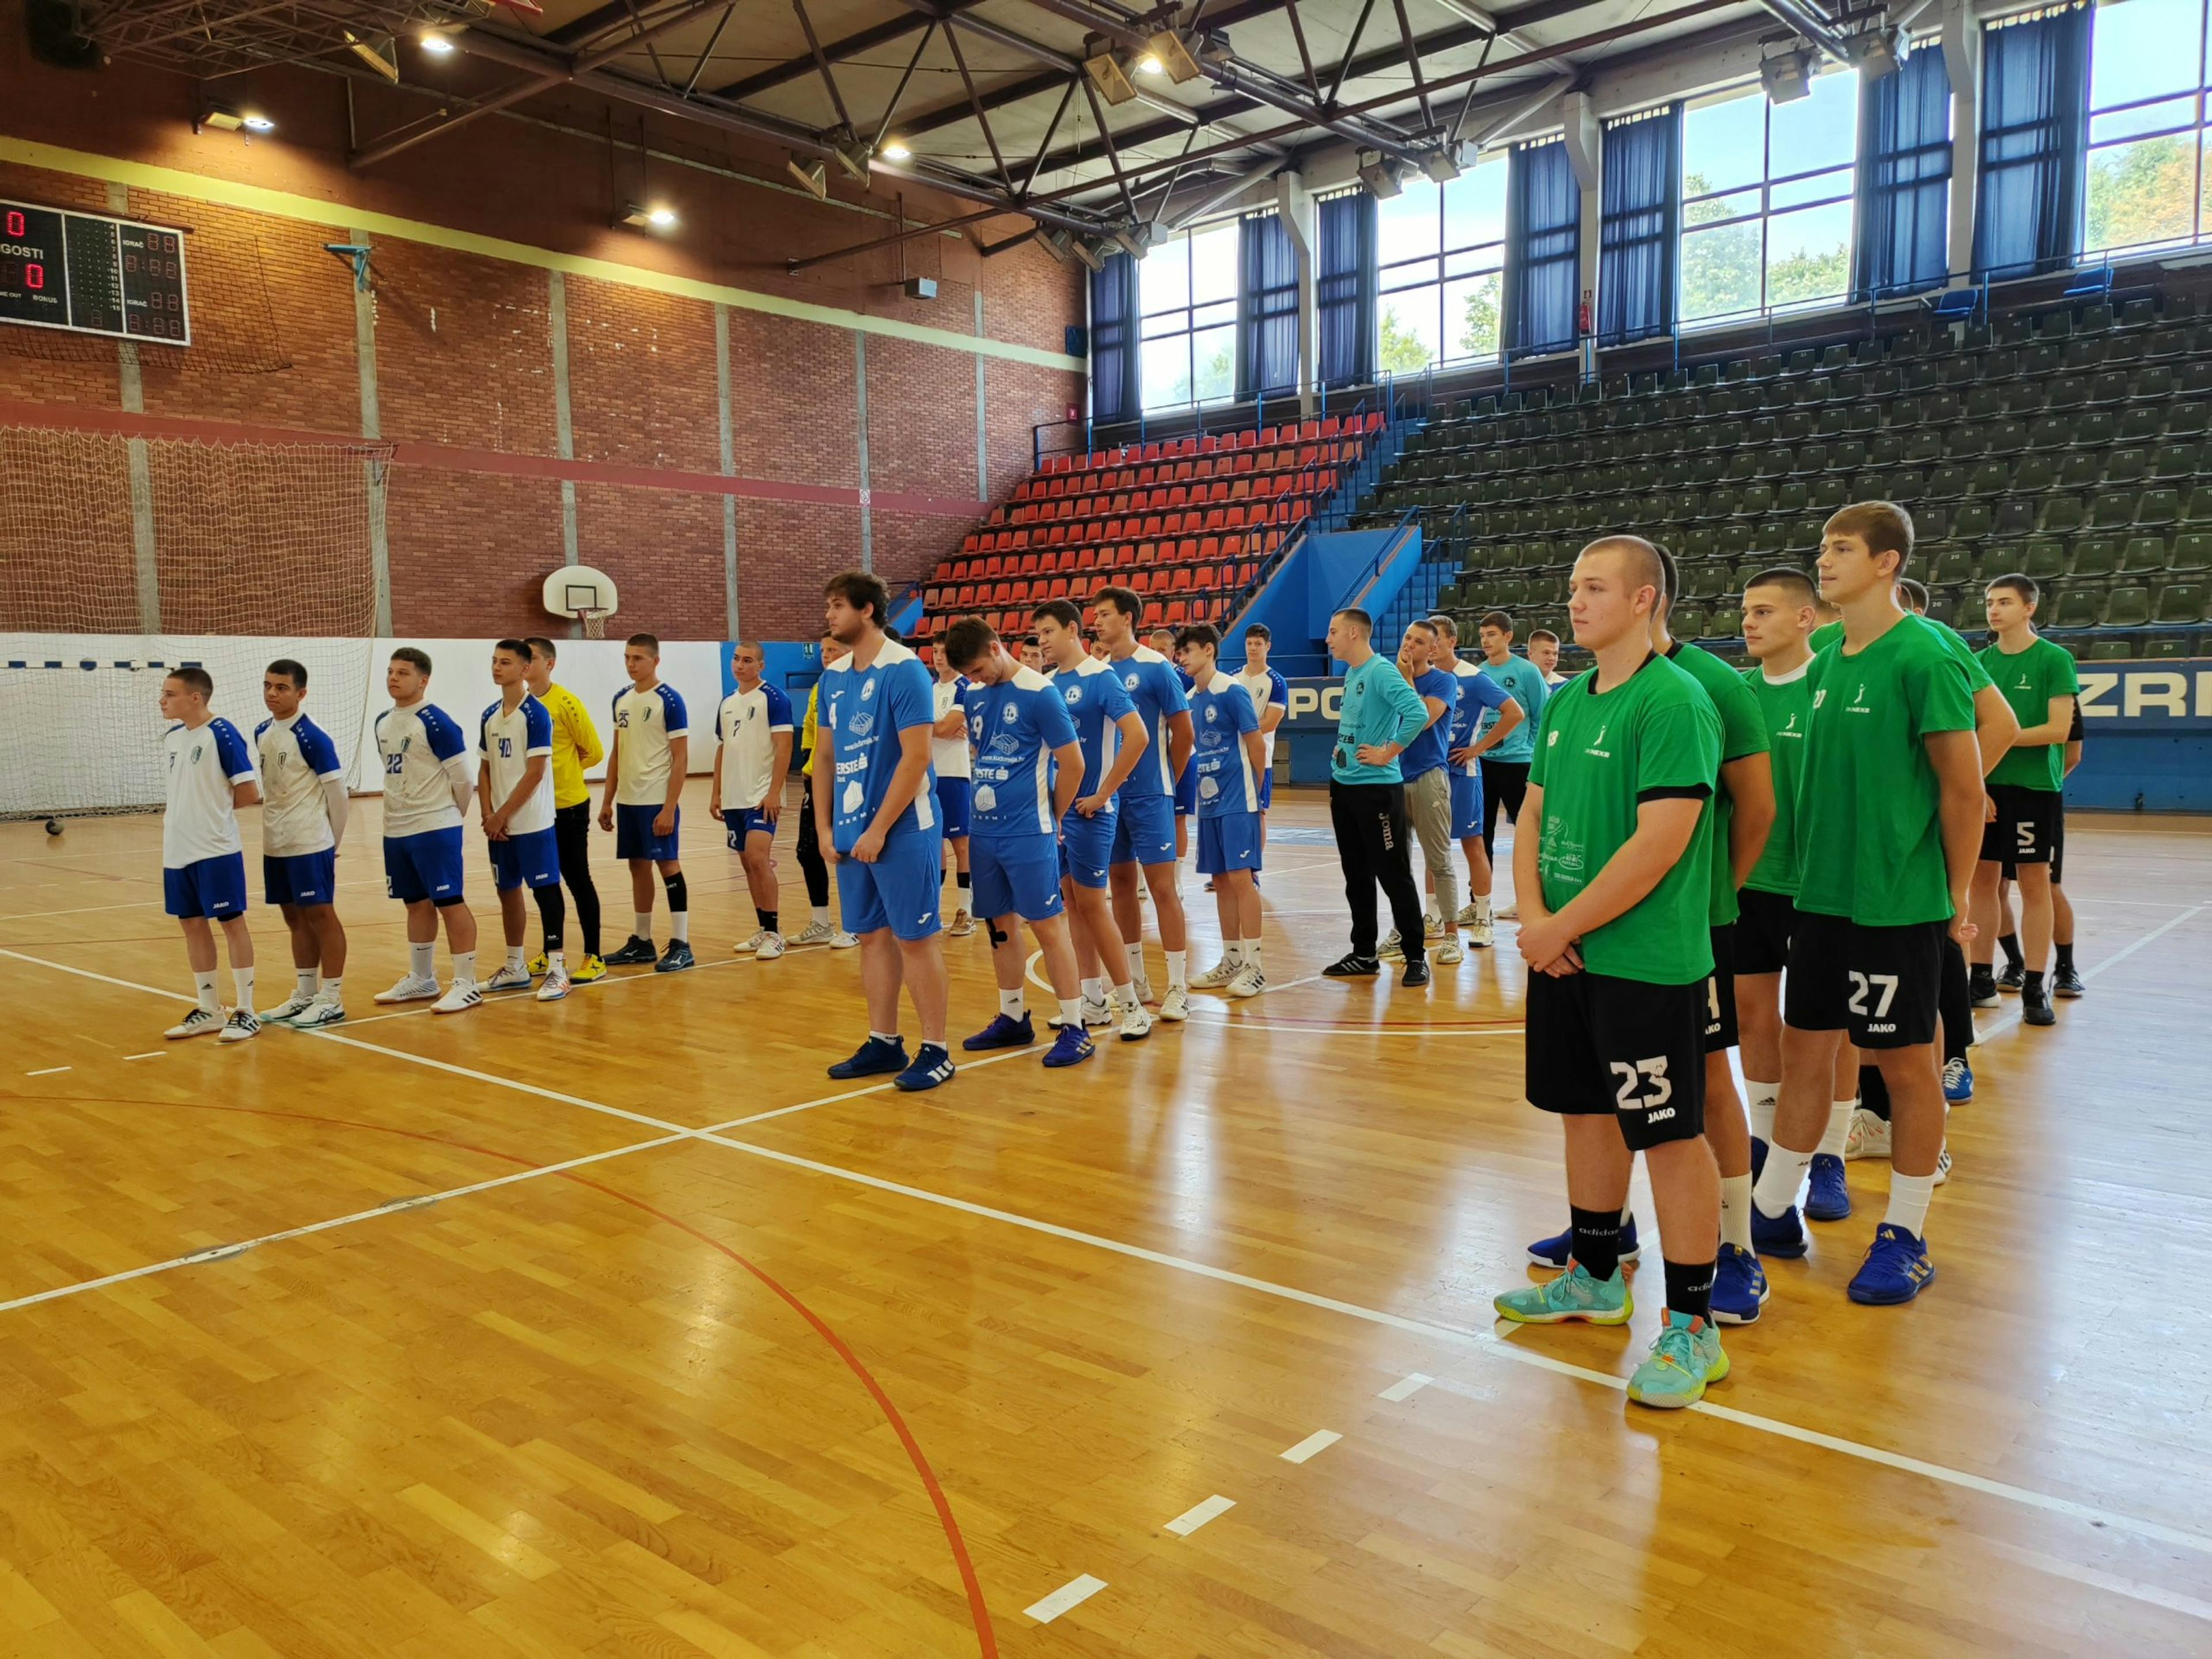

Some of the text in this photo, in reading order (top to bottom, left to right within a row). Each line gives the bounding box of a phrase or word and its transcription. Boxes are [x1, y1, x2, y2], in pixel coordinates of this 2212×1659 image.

[7, 211, 25, 237] 0
[1, 243, 44, 260] GOSTI
[26, 263, 44, 289] 0
[33, 294, 58, 304] BONUS
[733, 719, 741, 737] 7
[387, 753, 403, 774] 22
[836, 759, 859, 775] ERSTE
[1378, 812, 1395, 851] Joma
[2017, 821, 2035, 846] 5
[1849, 970, 1899, 1017] 27
[1867, 1023, 1896, 1033] JAKO
[1609, 1055, 1672, 1110] 23
[1647, 1107, 1676, 1124] JAKO
